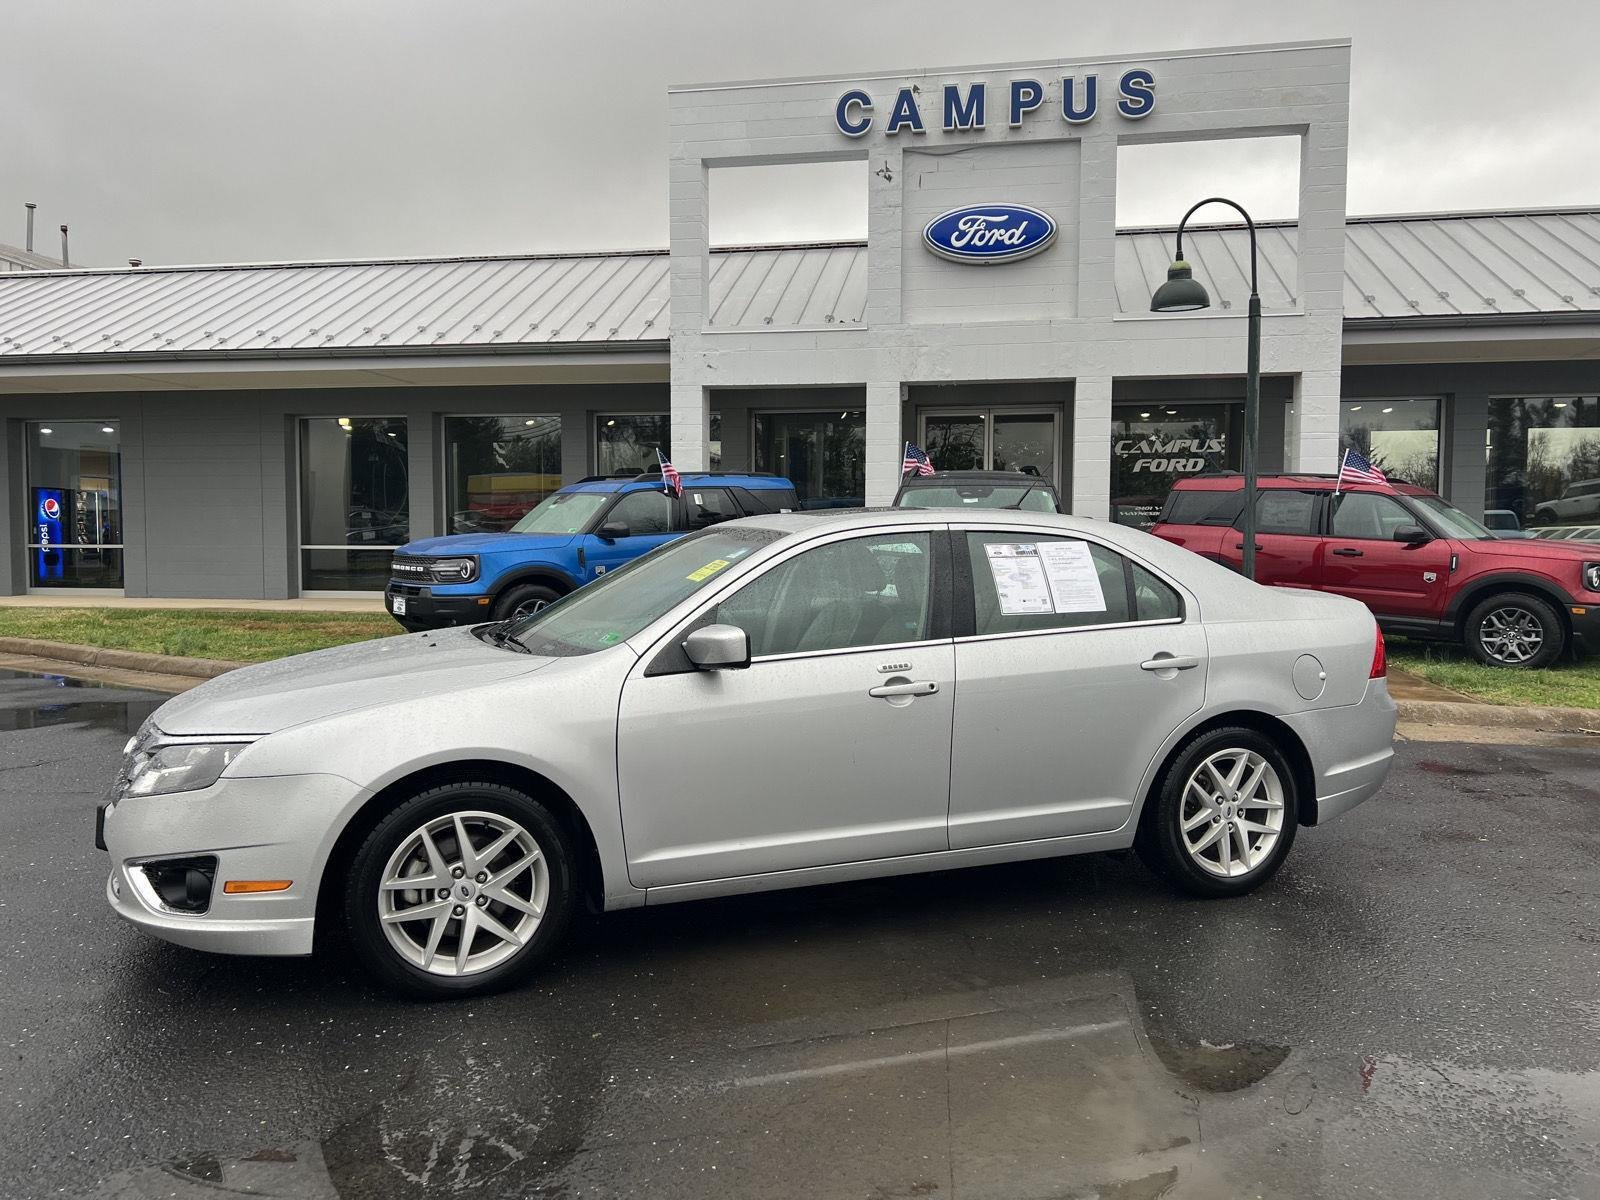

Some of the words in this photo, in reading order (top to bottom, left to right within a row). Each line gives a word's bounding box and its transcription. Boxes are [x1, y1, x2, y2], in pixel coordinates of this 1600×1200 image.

[835, 68, 1156, 138] CAMPUS
[951, 214, 1027, 248] Ford
[1114, 438, 1226, 454] CAMPUS
[1132, 458, 1205, 473] FORD
